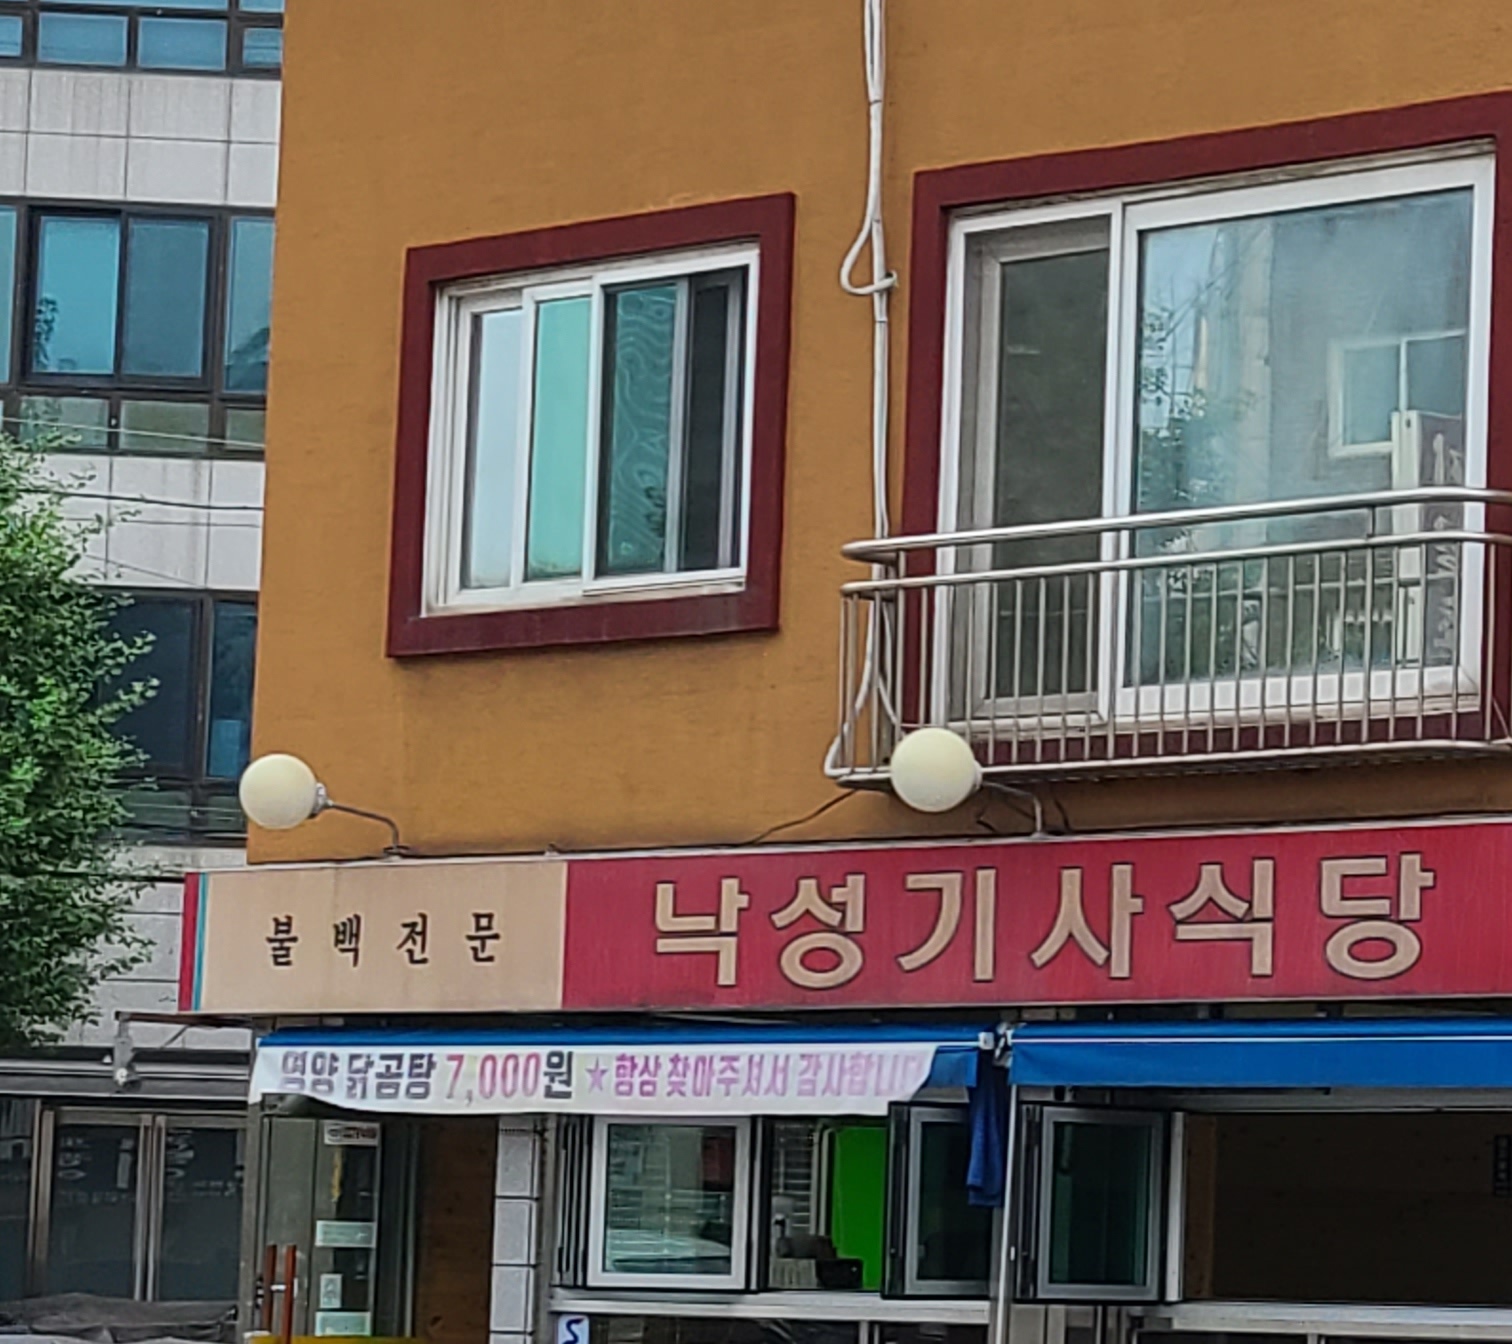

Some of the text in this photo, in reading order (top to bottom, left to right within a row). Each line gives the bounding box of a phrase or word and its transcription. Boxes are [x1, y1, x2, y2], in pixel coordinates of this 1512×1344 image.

[265, 912, 501, 968] 불백전문
[653, 852, 1435, 989] 낙성기사식당
[346, 1052, 437, 1100] 닭곰탕
[446, 1050, 574, 1106] 7,000원
[614, 1052, 662, 1098] 항상
[666, 1052, 788, 1098] 찾아주셔서
